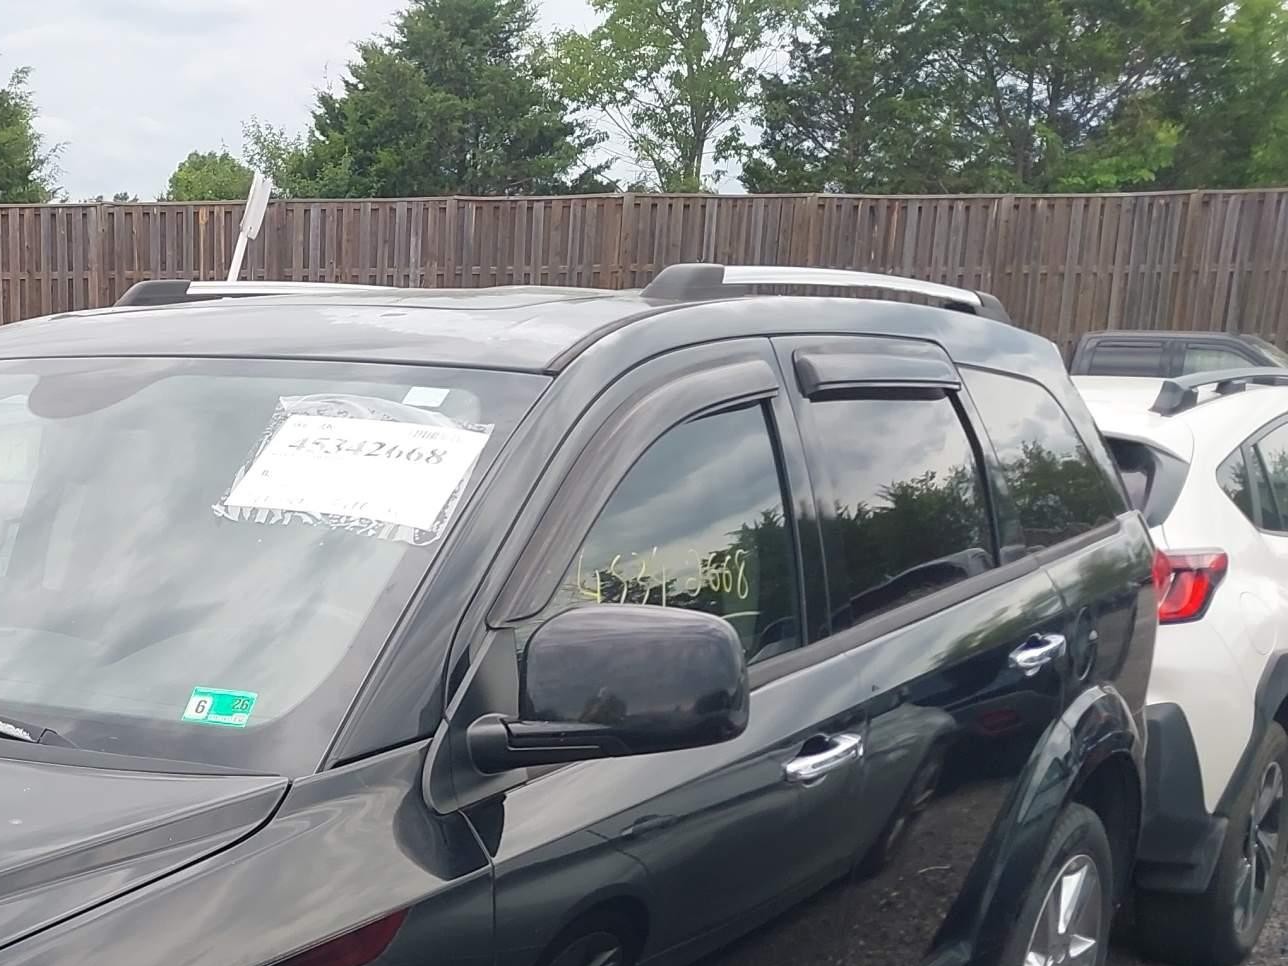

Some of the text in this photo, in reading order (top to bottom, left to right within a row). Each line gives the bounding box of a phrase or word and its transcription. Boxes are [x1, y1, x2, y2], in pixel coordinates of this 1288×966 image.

[287, 436, 448, 465] 45342668
[195, 698, 250, 714] 6 26
